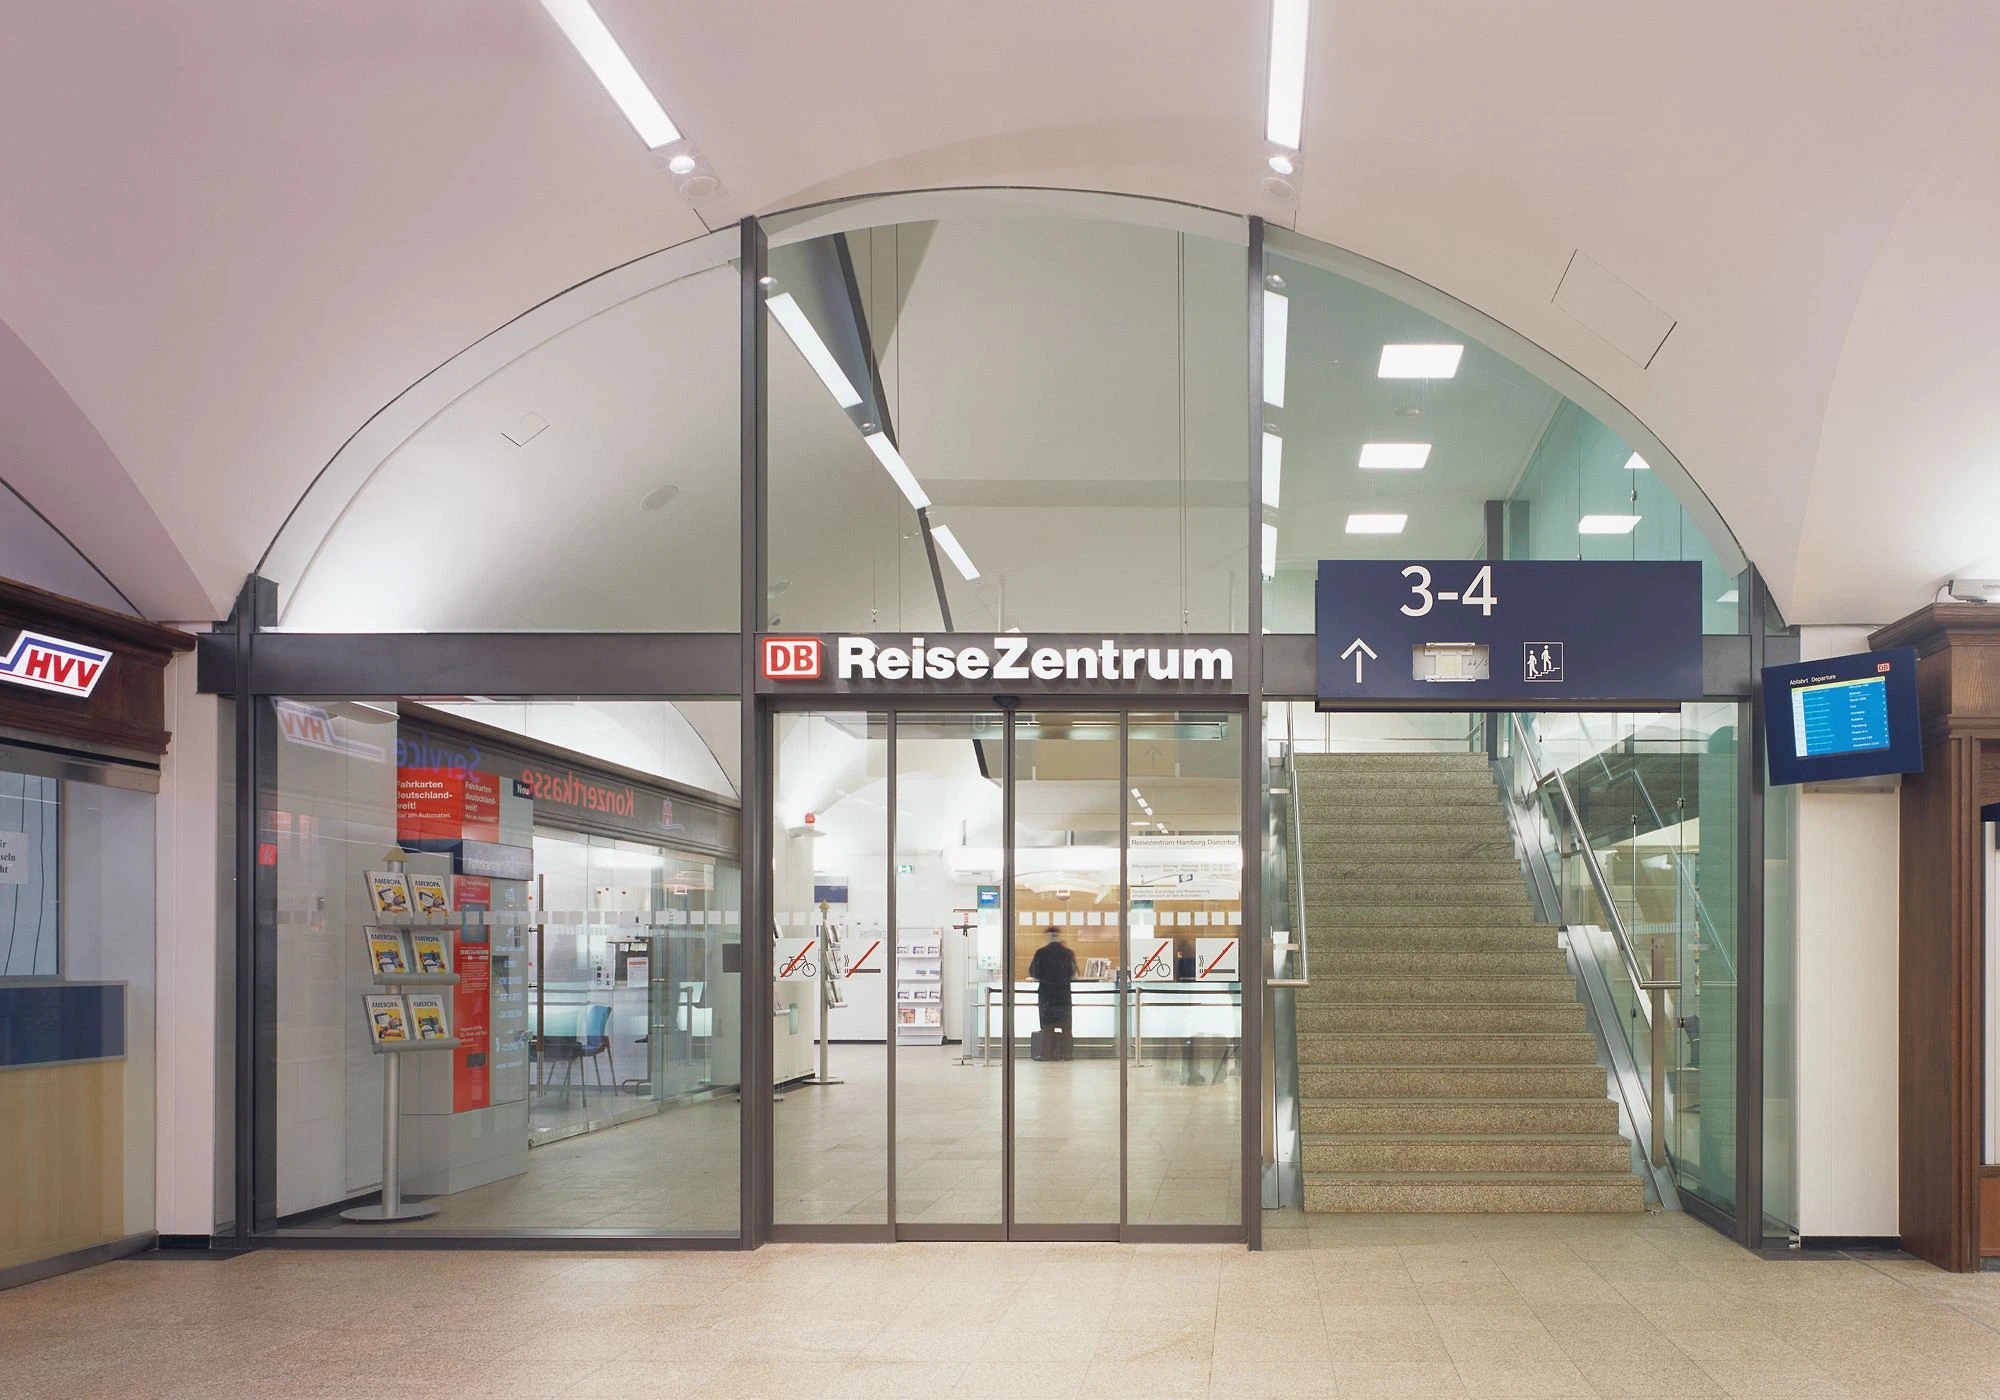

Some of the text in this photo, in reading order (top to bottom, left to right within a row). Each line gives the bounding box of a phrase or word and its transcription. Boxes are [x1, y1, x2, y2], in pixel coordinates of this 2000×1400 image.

[1400, 565, 1497, 617] 3-4
[25, 649, 100, 688] HVV
[770, 637, 1233, 680] DB ReiseZentrum
[1878, 664, 1889, 672] DB
[1789, 674, 1837, 686] Abfahrt Departure
[1176, 839, 1206, 847] Hamburg
